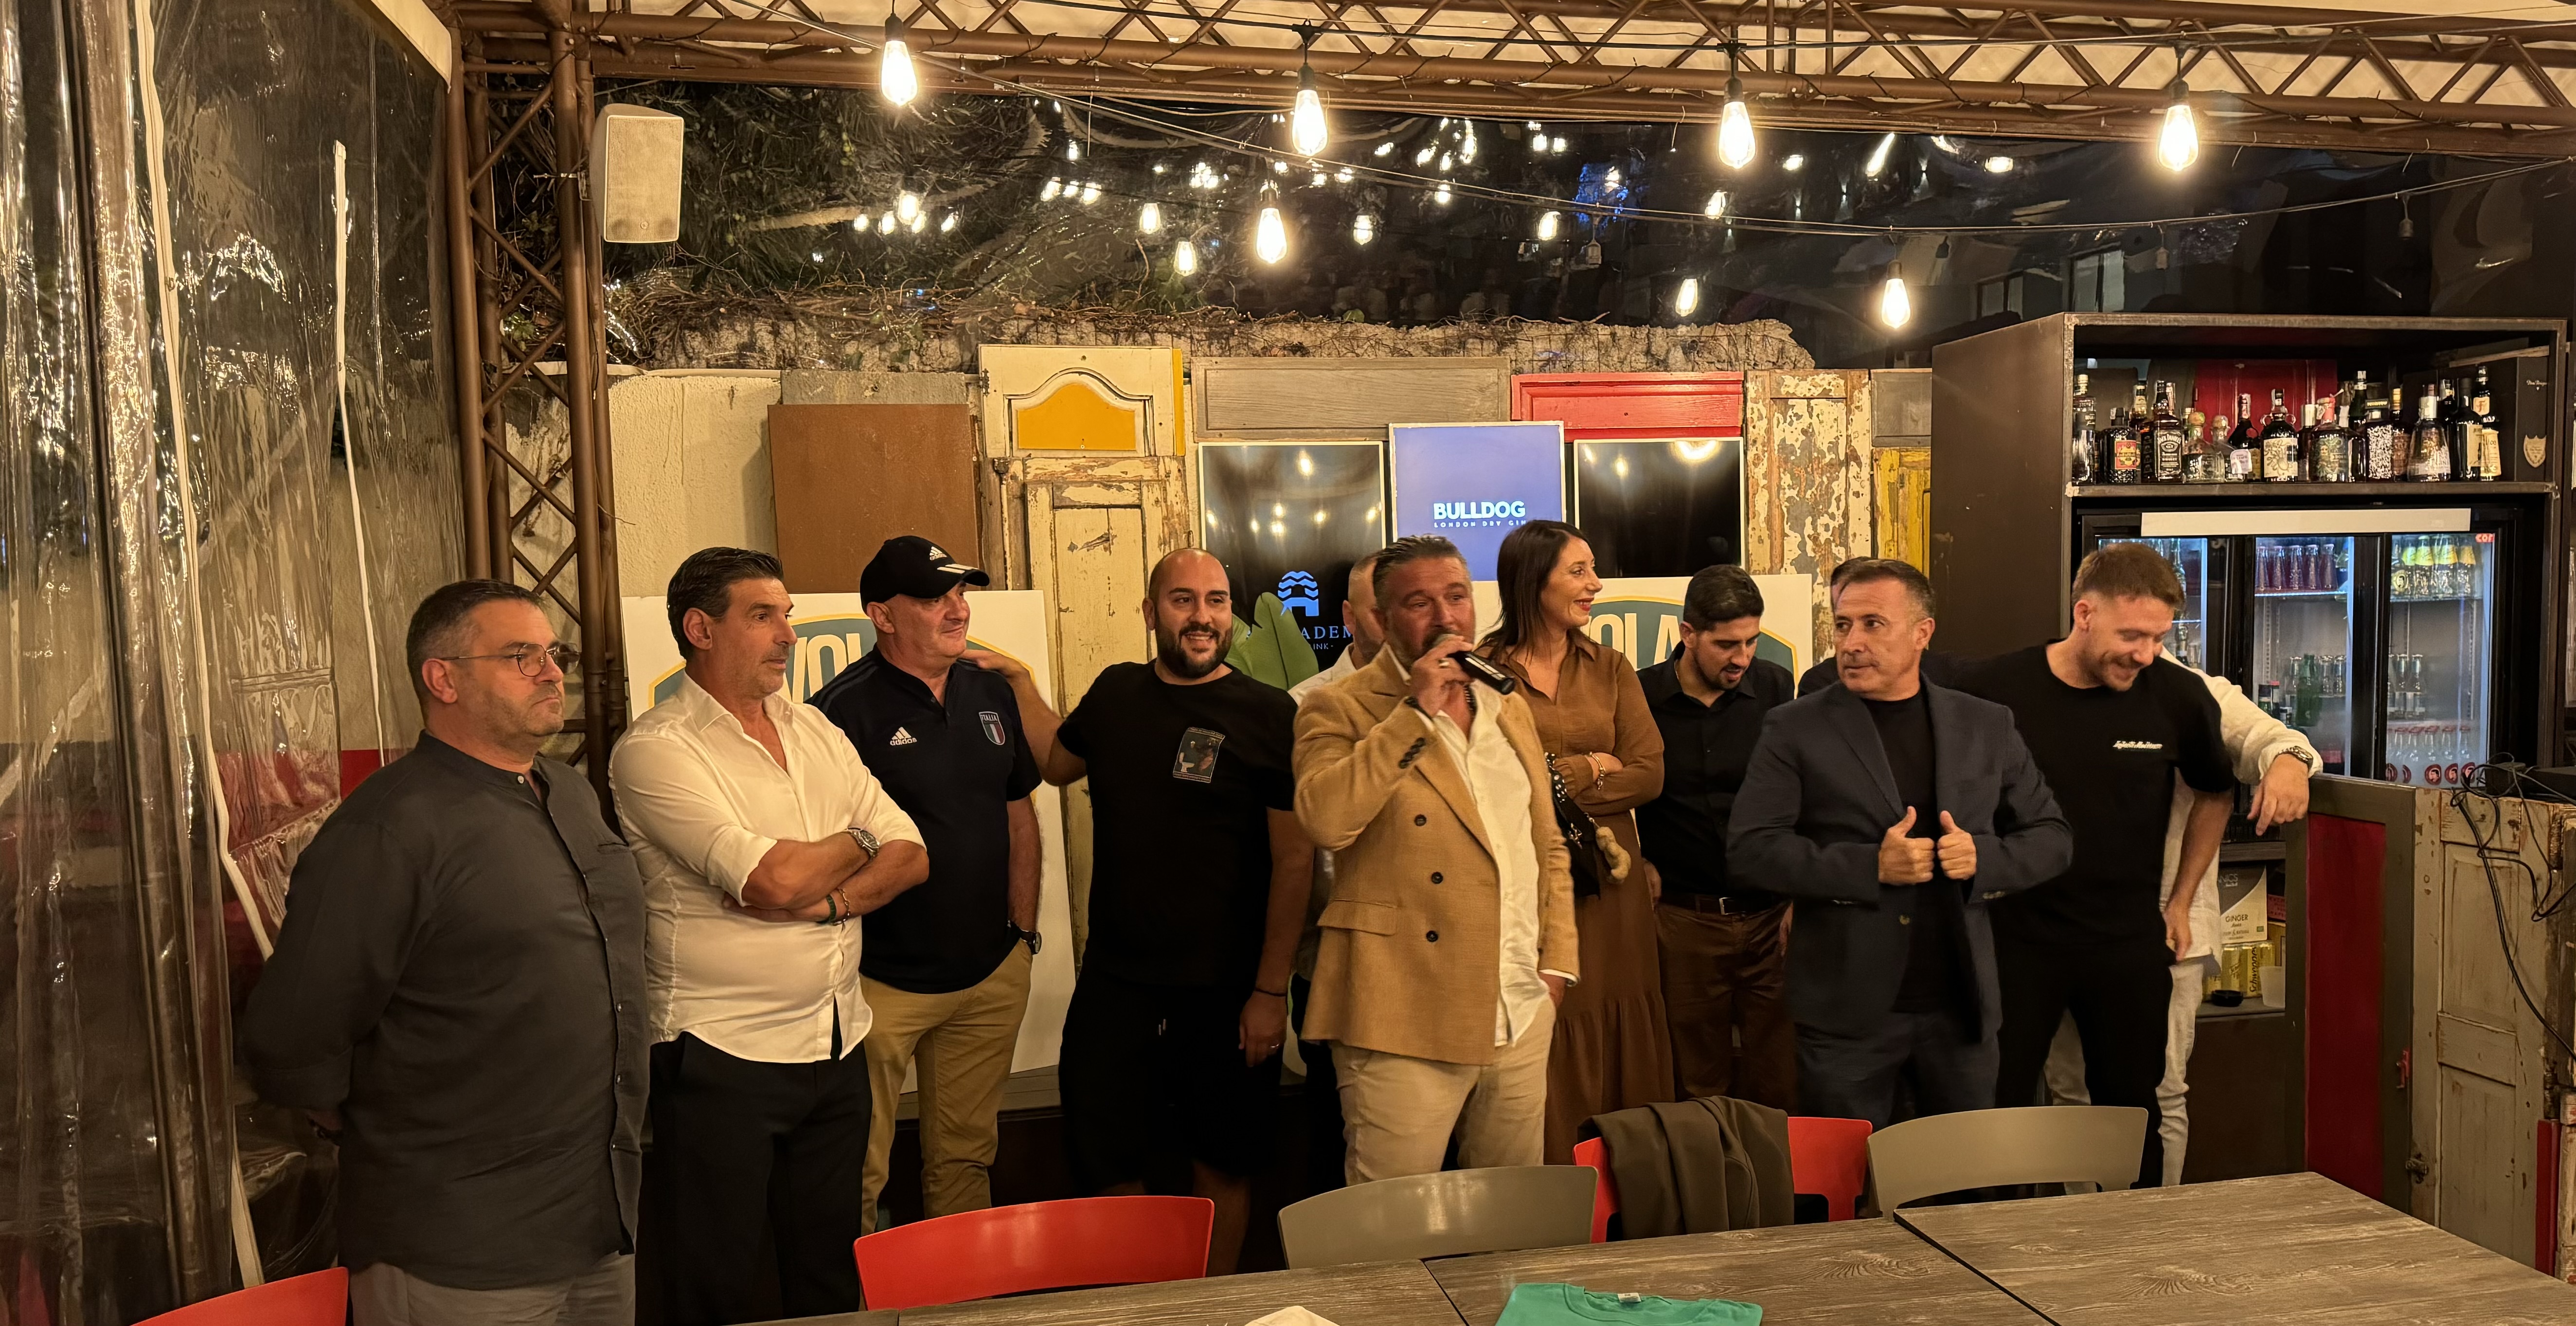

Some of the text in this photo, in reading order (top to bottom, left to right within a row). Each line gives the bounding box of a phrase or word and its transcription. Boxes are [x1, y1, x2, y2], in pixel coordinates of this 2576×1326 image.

[1433, 501, 1526, 520] BULLDOG
[890, 737, 917, 746] adidas
[2225, 914, 2248, 922] GINGER
